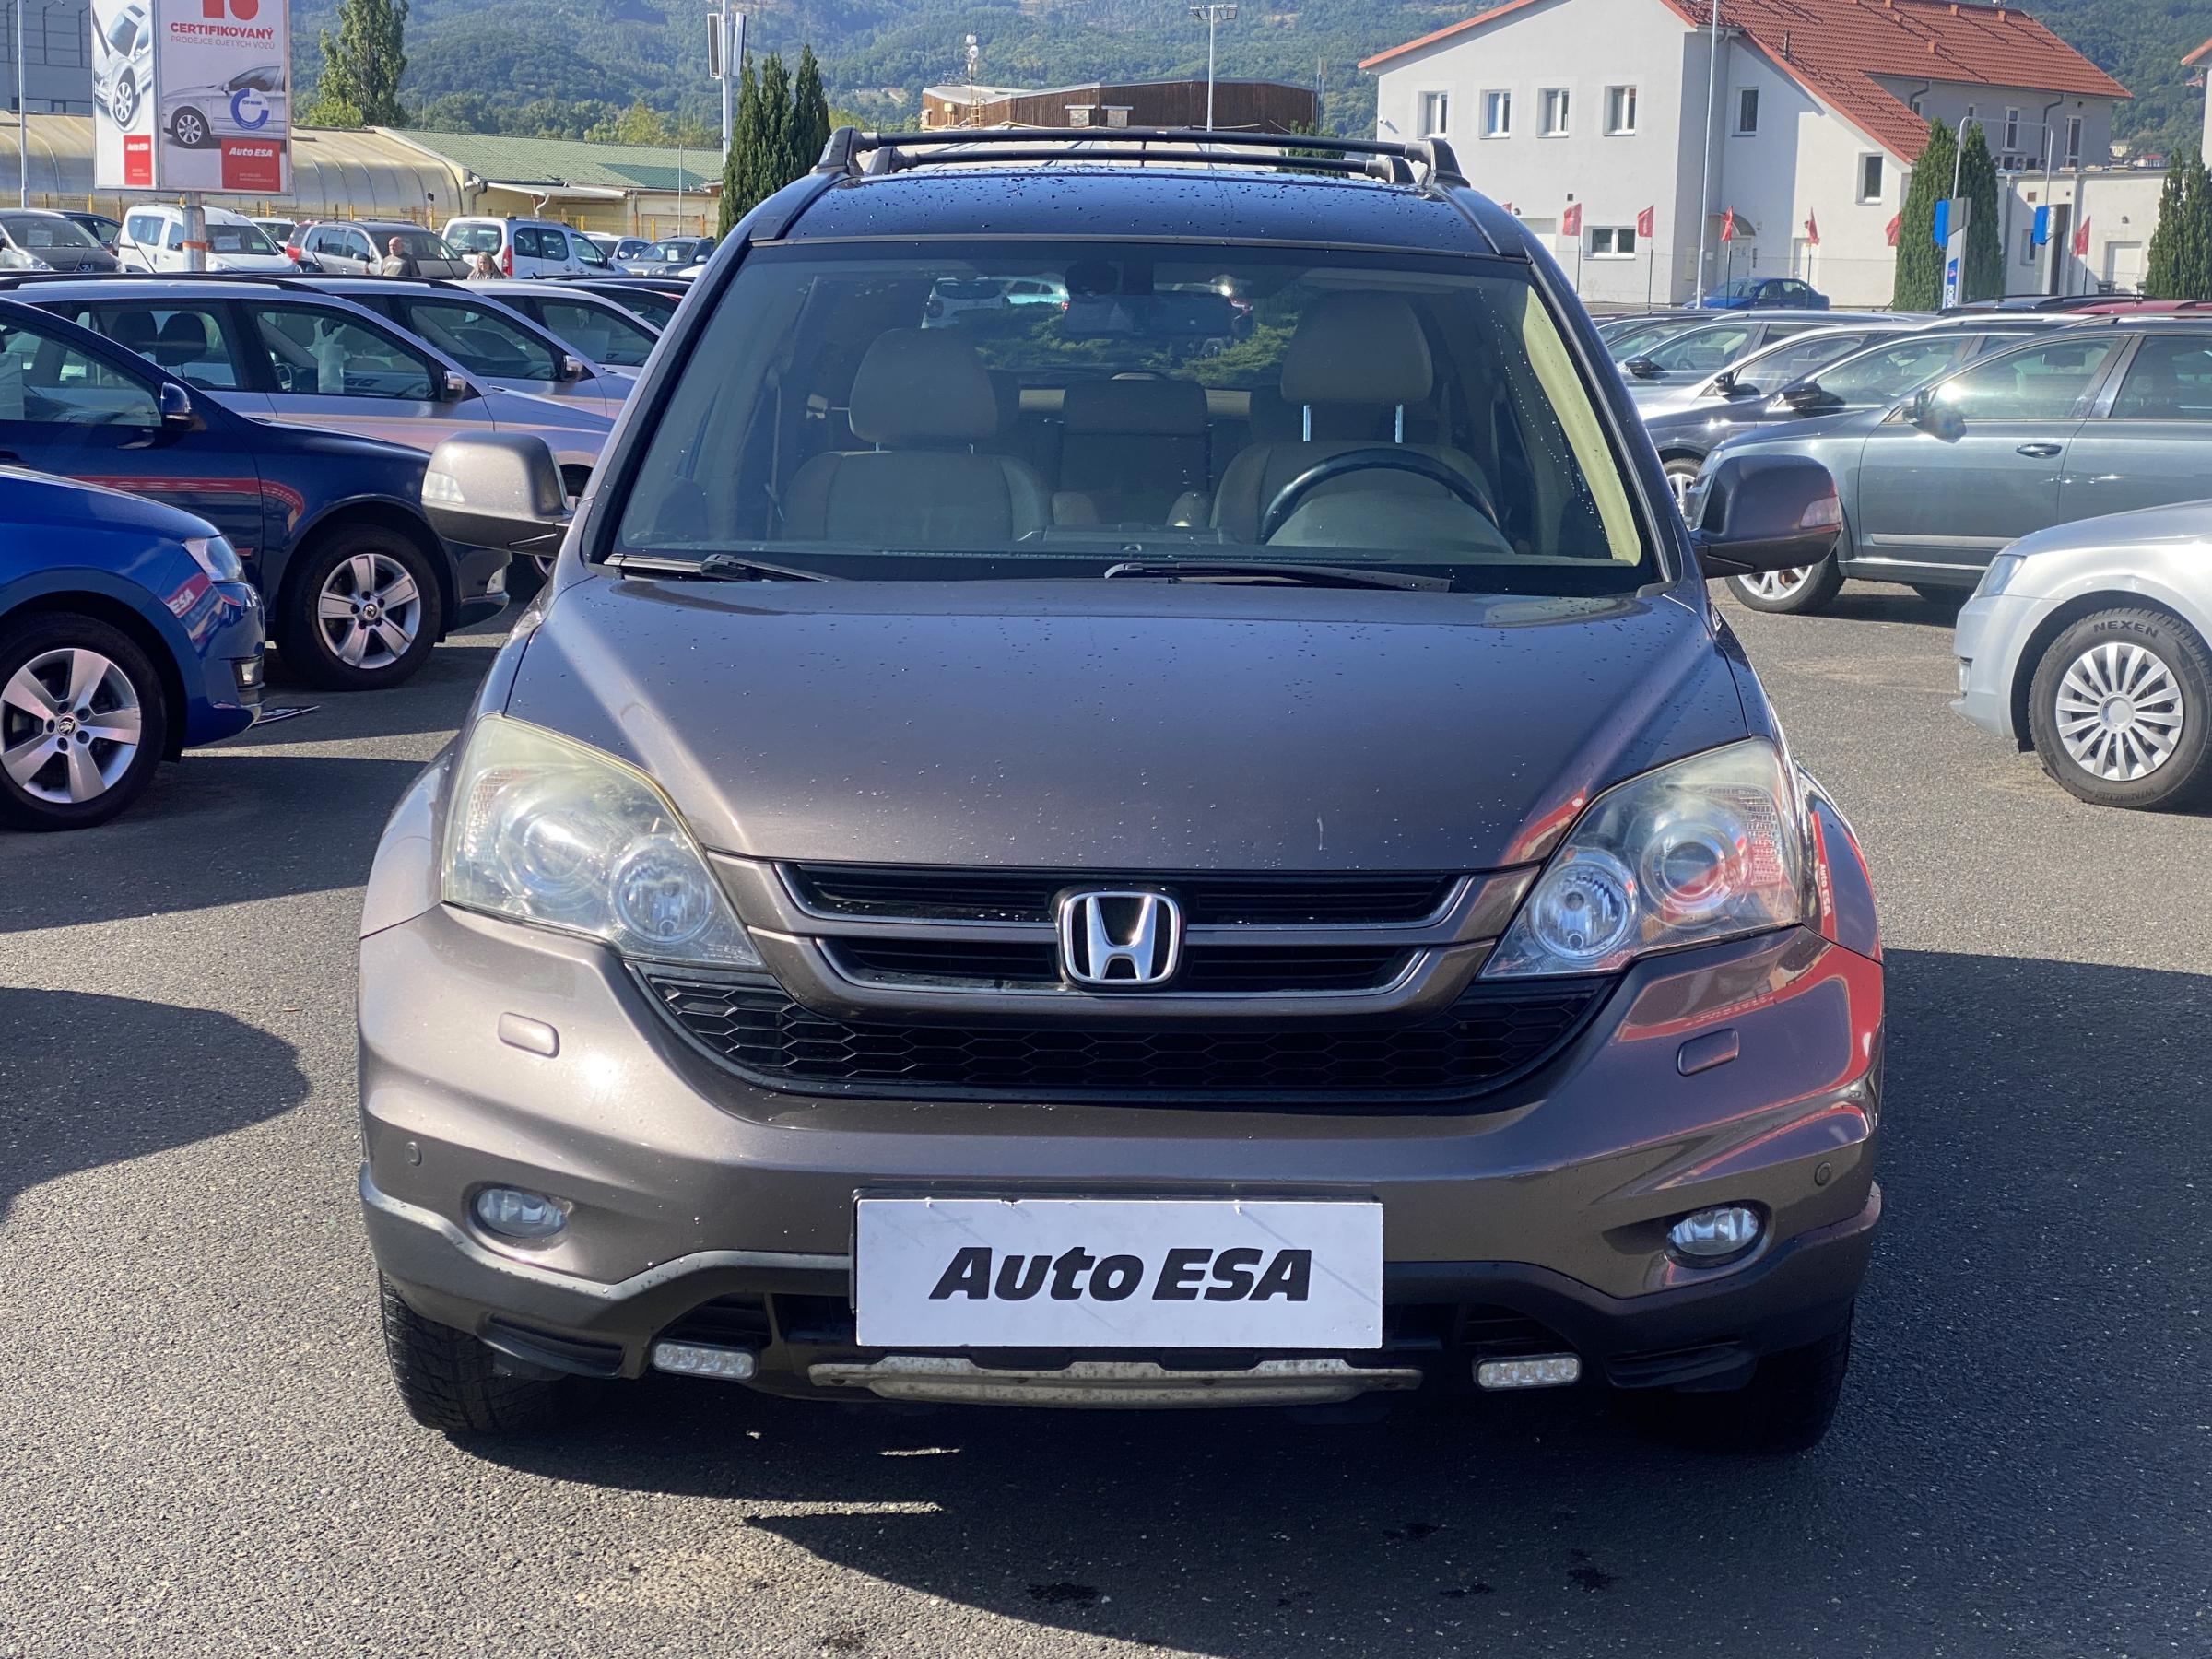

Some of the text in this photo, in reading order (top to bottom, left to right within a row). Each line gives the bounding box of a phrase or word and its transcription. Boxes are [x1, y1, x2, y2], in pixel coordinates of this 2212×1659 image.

[170, 22, 274, 40] CERTIFIKOVANÝ
[171, 35, 213, 45] PRODEJCE
[229, 147, 273, 157] Auto ESA
[2093, 619, 2159, 639] NEXEN
[927, 1246, 1312, 1302] Auto ESA
